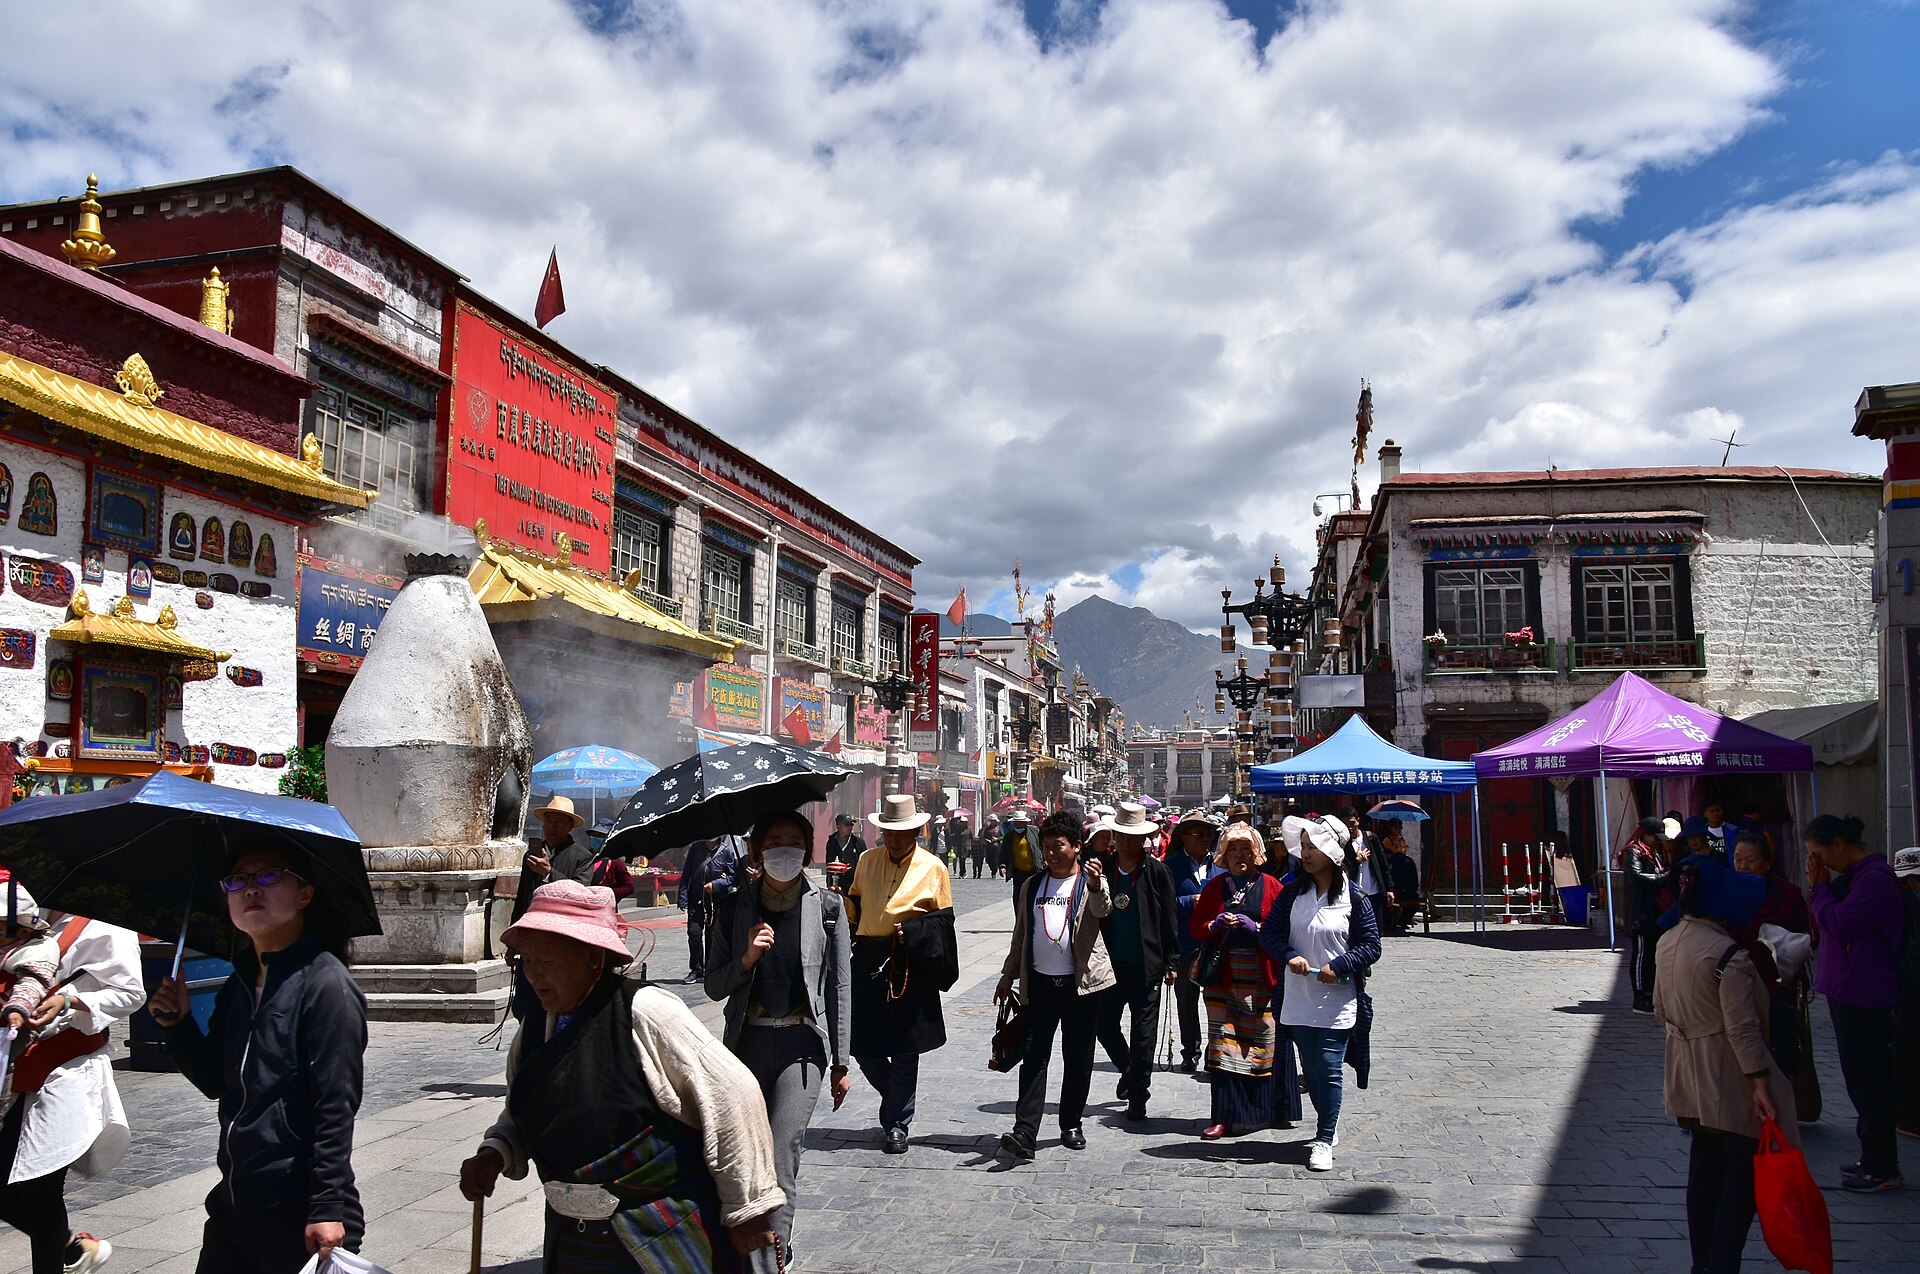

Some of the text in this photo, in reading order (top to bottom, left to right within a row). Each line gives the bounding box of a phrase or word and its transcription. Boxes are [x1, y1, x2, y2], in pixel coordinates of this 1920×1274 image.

[497, 399, 600, 479] 西藏赛康旅游购物中心
[495, 473, 509, 494] TIBET
[1535, 755, 1566, 770] 满满信任
[1715, 752, 1765, 766] 满满信任
[1283, 770, 1443, 787] 拉萨市公安局110便民警务站
